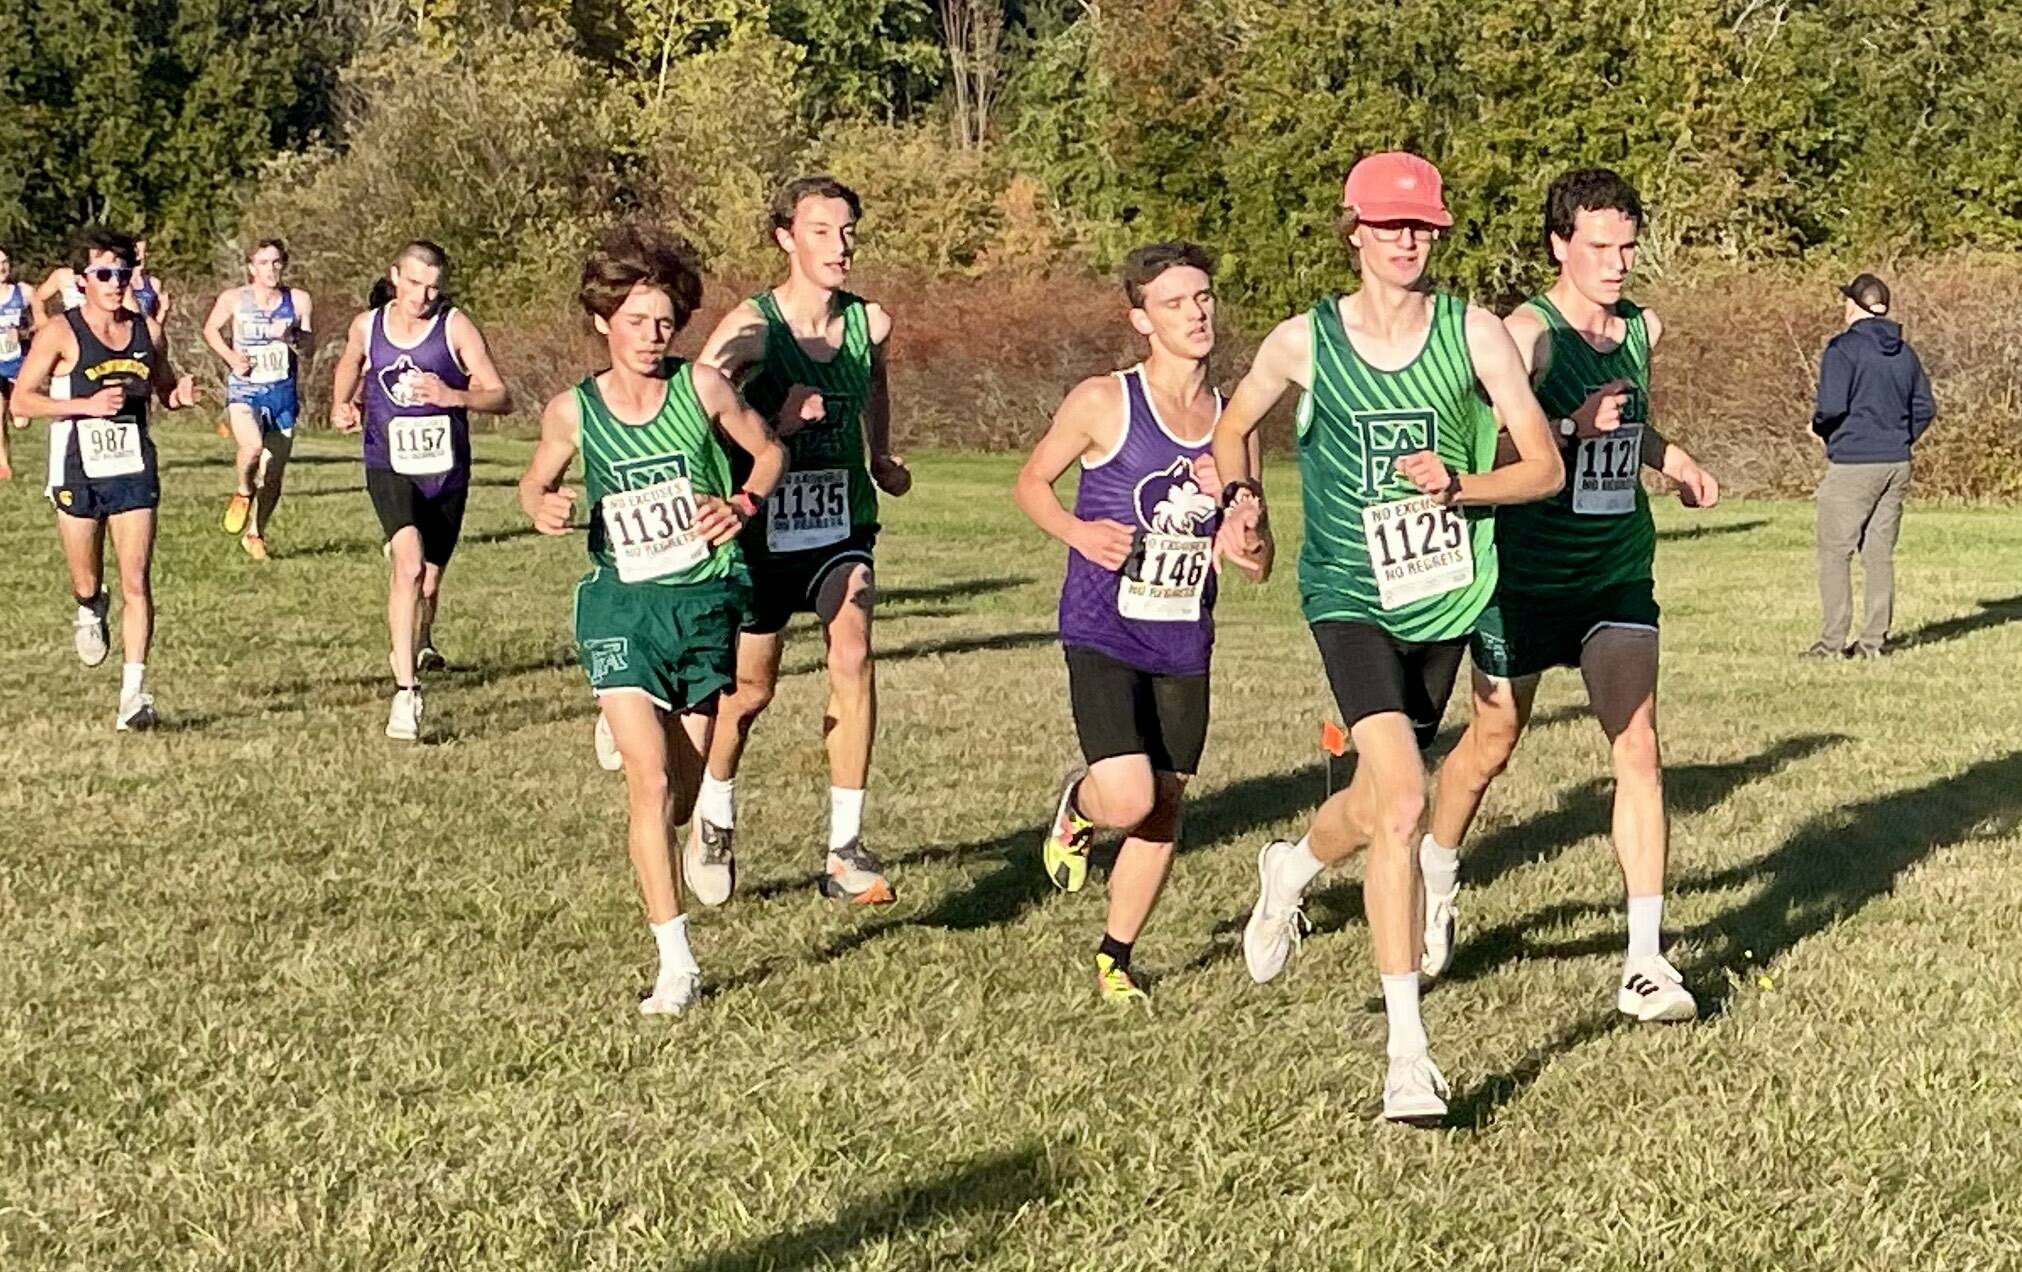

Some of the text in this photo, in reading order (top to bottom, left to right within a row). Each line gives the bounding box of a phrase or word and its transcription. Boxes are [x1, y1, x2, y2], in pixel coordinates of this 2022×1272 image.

[91, 426, 128, 454] 987
[396, 427, 446, 452] 1157
[774, 482, 844, 520] 1135
[1371, 498, 1438, 522] NO EXCU
[614, 495, 694, 547] 1130
[1374, 505, 1463, 567] 1125
[1133, 549, 1207, 587] 1146
[1384, 549, 1464, 582] NO REGRETS
